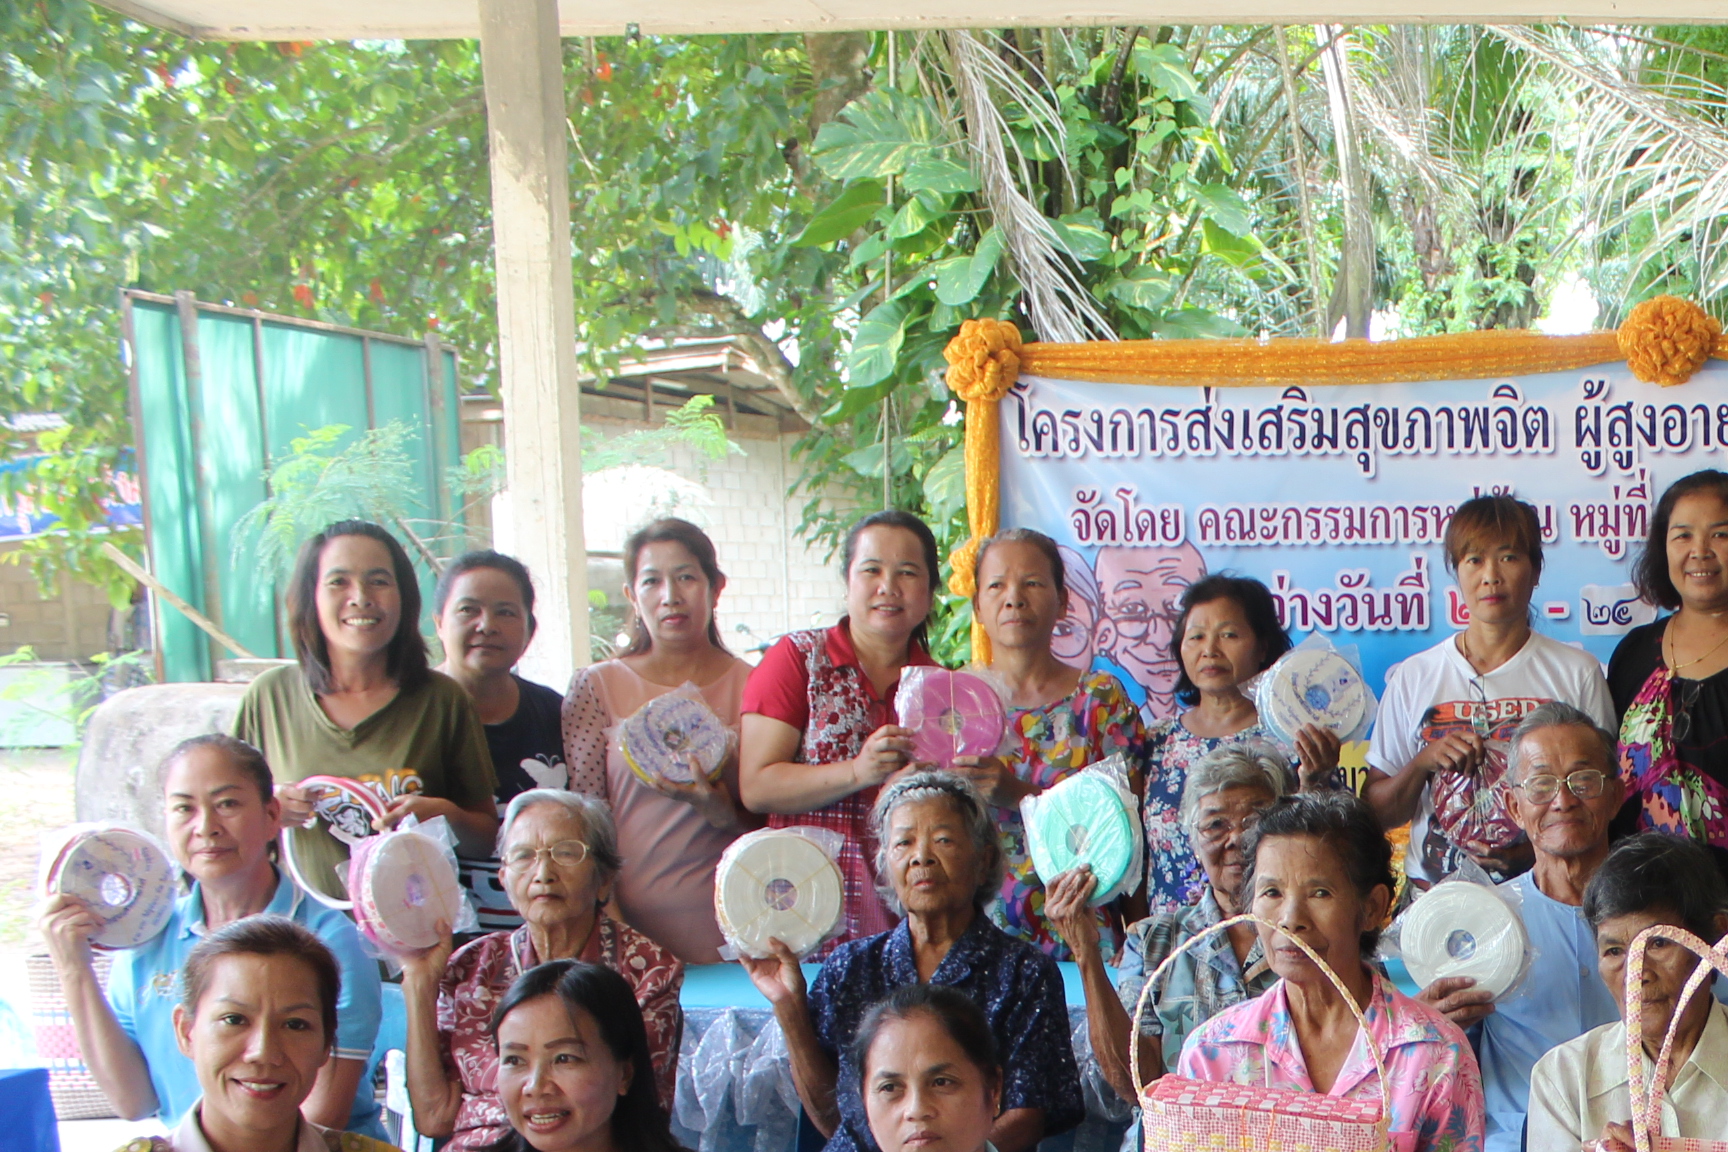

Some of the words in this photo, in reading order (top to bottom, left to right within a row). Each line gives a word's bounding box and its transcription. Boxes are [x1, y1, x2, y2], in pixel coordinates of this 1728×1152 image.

[1007, 382, 1549, 472] โครงการส่งเสริมสุขภาพจิต
[1071, 489, 1180, 541] จัดโดย
[1570, 468, 1647, 554] หมู่ที่
